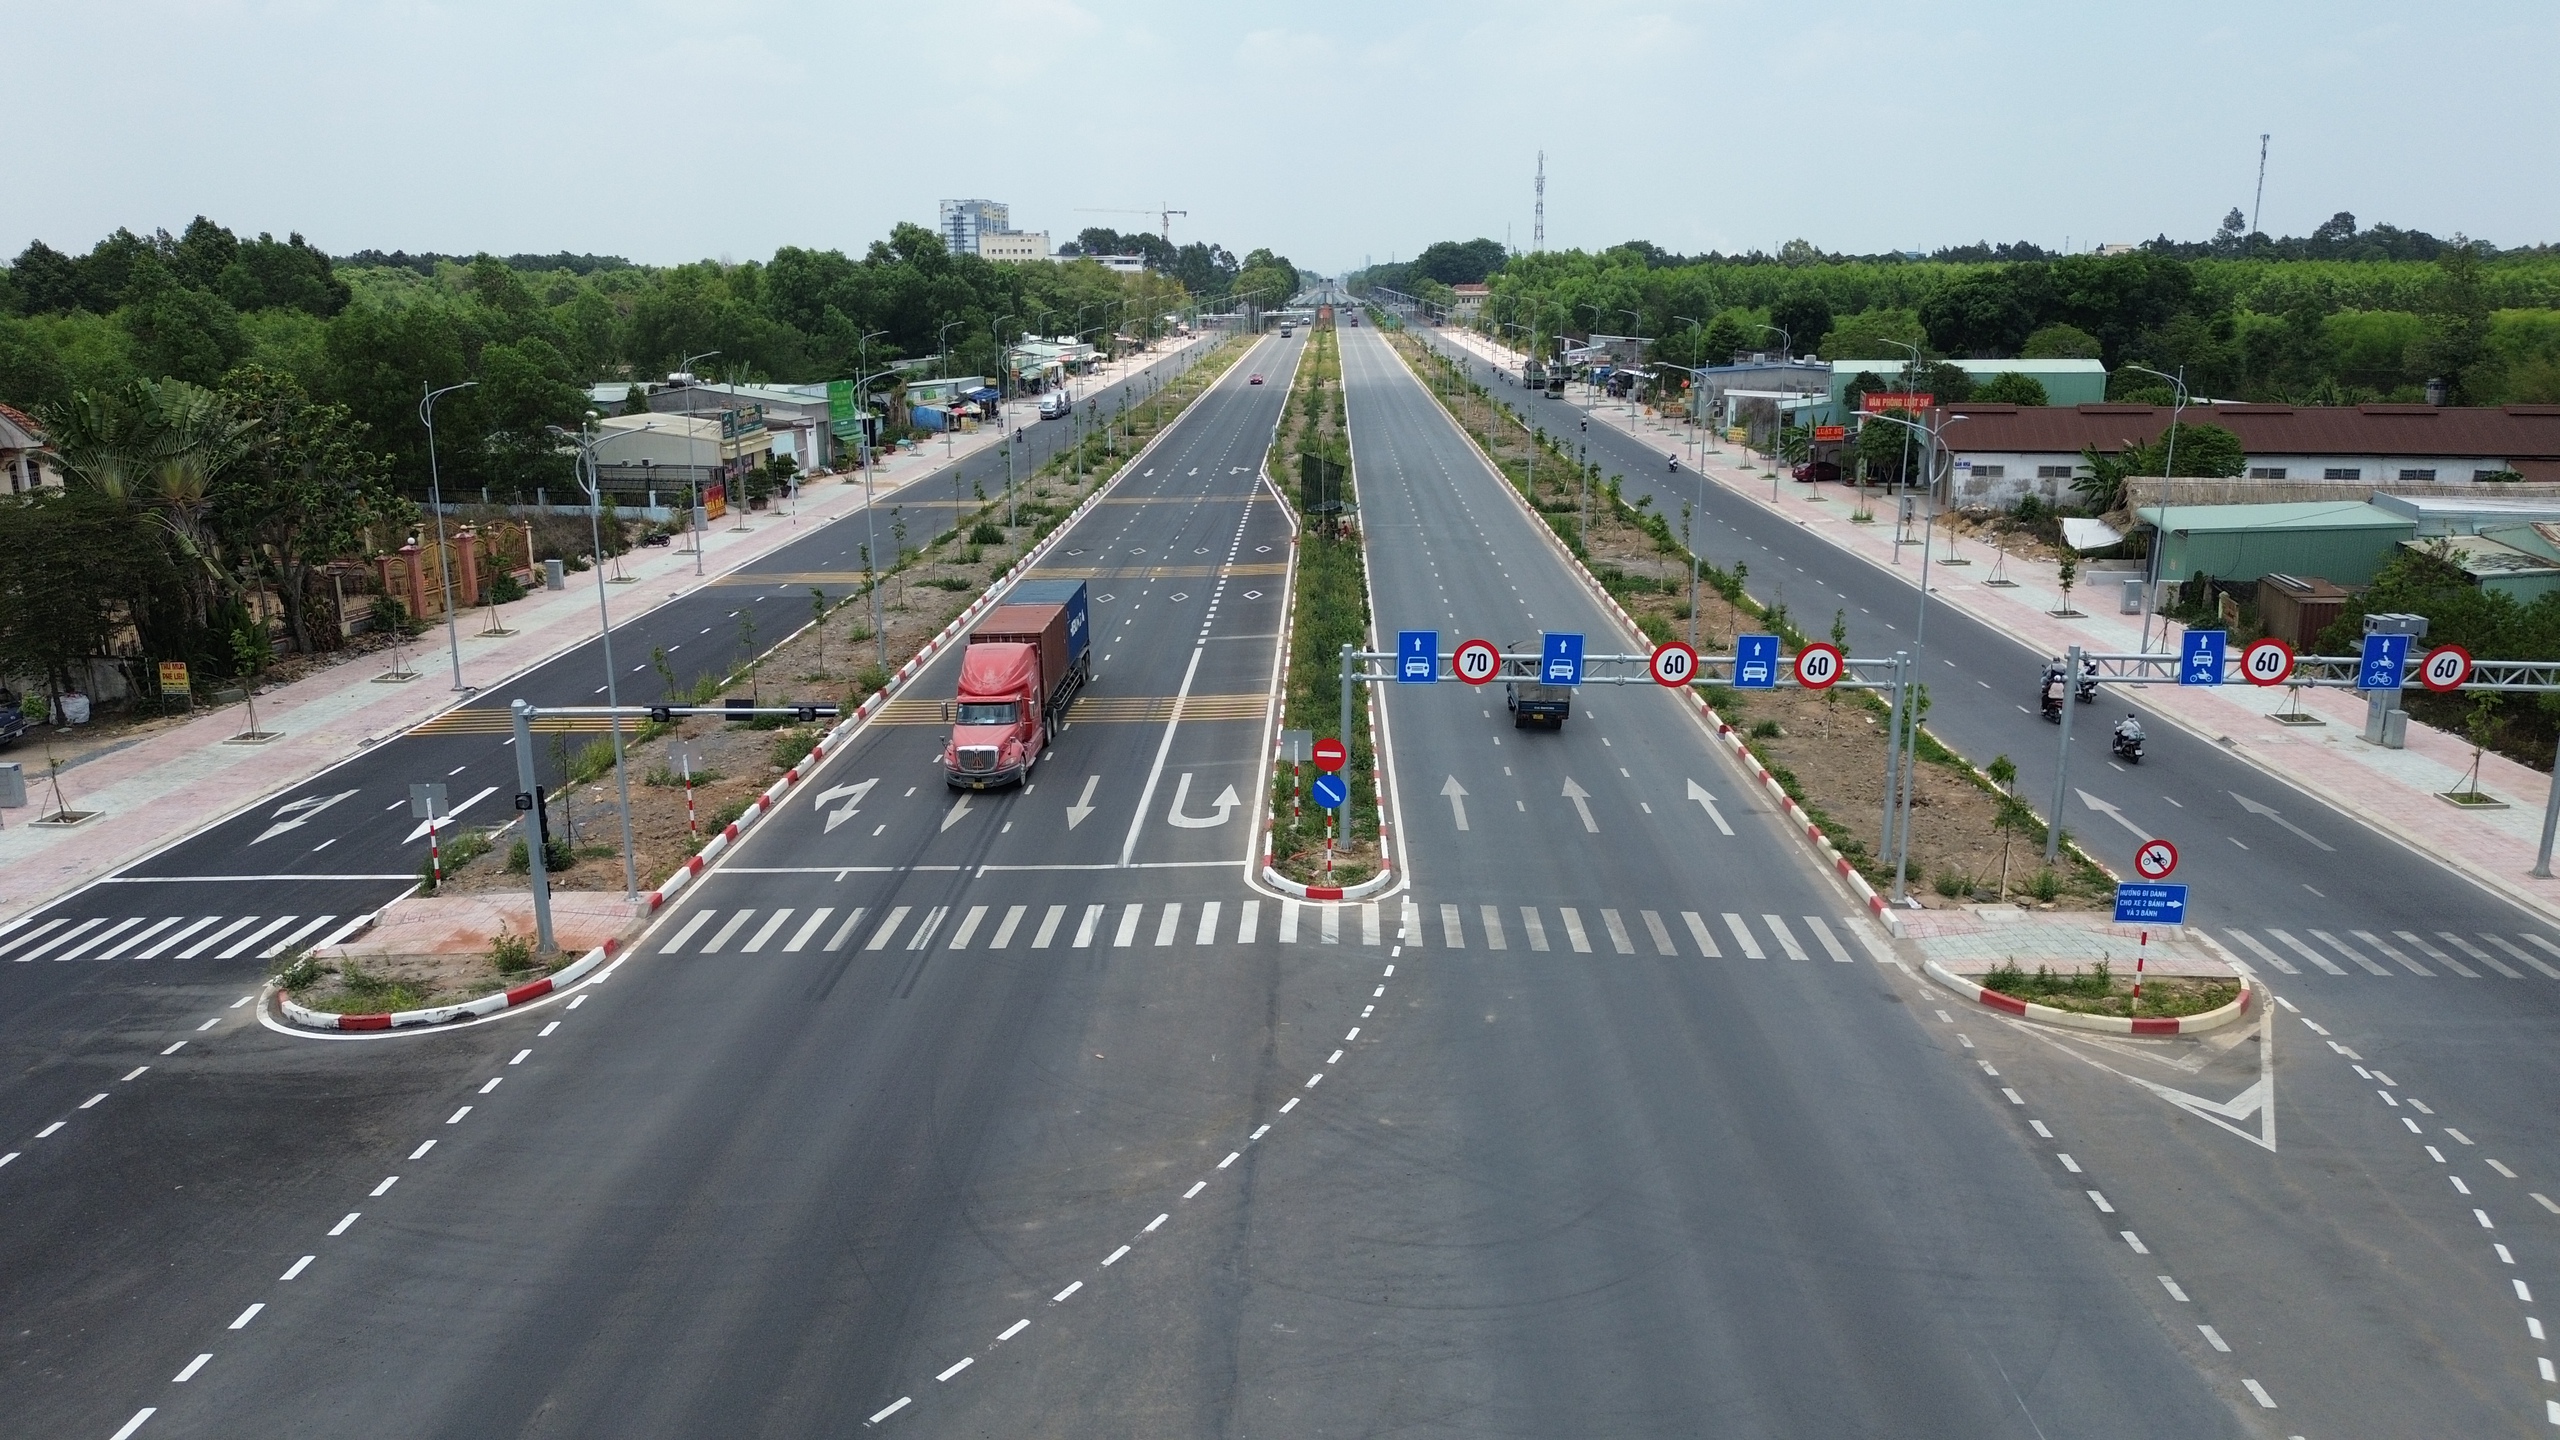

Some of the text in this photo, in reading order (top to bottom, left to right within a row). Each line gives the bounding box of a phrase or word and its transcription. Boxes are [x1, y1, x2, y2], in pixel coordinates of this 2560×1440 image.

[1868, 396, 1880, 406] VĂN
[1882, 396, 1903, 406] PHÒNG
[1920, 398, 1929, 406] SƯ
[1466, 653, 1487, 672] 70
[1663, 655, 1685, 674] 60
[1807, 657, 1828, 676] 60
[2255, 652, 2279, 672] 60
[2433, 658, 2457, 678] 60
[2119, 888, 2167, 898] HƯỚNG ĐI DÀNH
[2148, 899, 2165, 907] BÁNH
[2140, 909, 2158, 917] BÁNH
